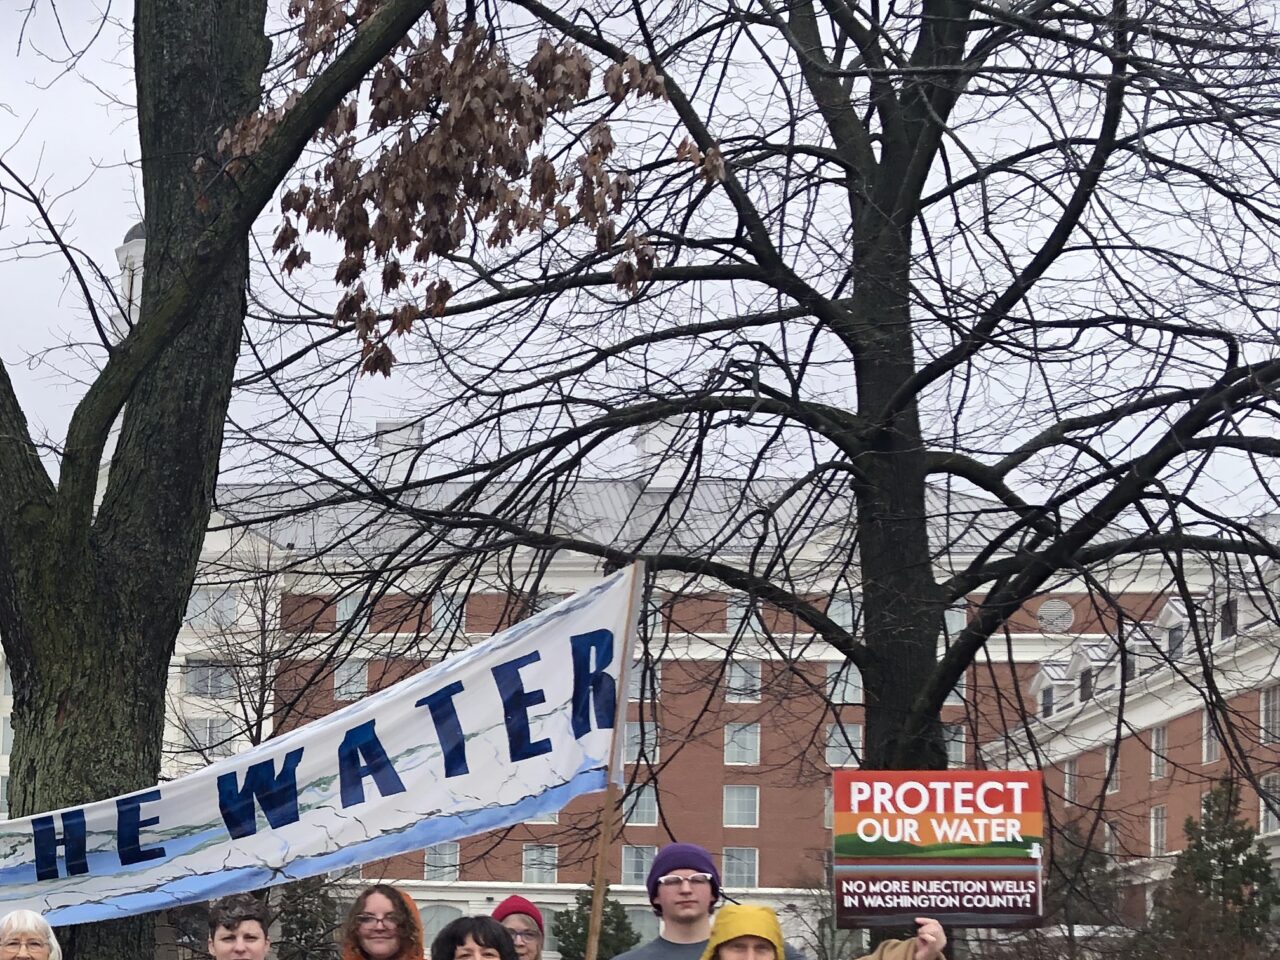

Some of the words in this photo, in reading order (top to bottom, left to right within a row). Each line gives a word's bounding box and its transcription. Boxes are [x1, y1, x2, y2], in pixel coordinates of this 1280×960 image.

[217, 628, 616, 840] WATER
[850, 781, 1029, 814] PROTECT
[857, 818, 920, 842] OUR
[930, 818, 1023, 842] WATER
[842, 881, 866, 893] NO
[869, 881, 909, 893] MORE
[912, 881, 987, 893] INJECTION
[989, 881, 1036, 893] WELLS
[844, 895, 858, 907] IN
[862, 895, 960, 908] WASHINGTON
[962, 895, 1031, 908] COUNTY!
